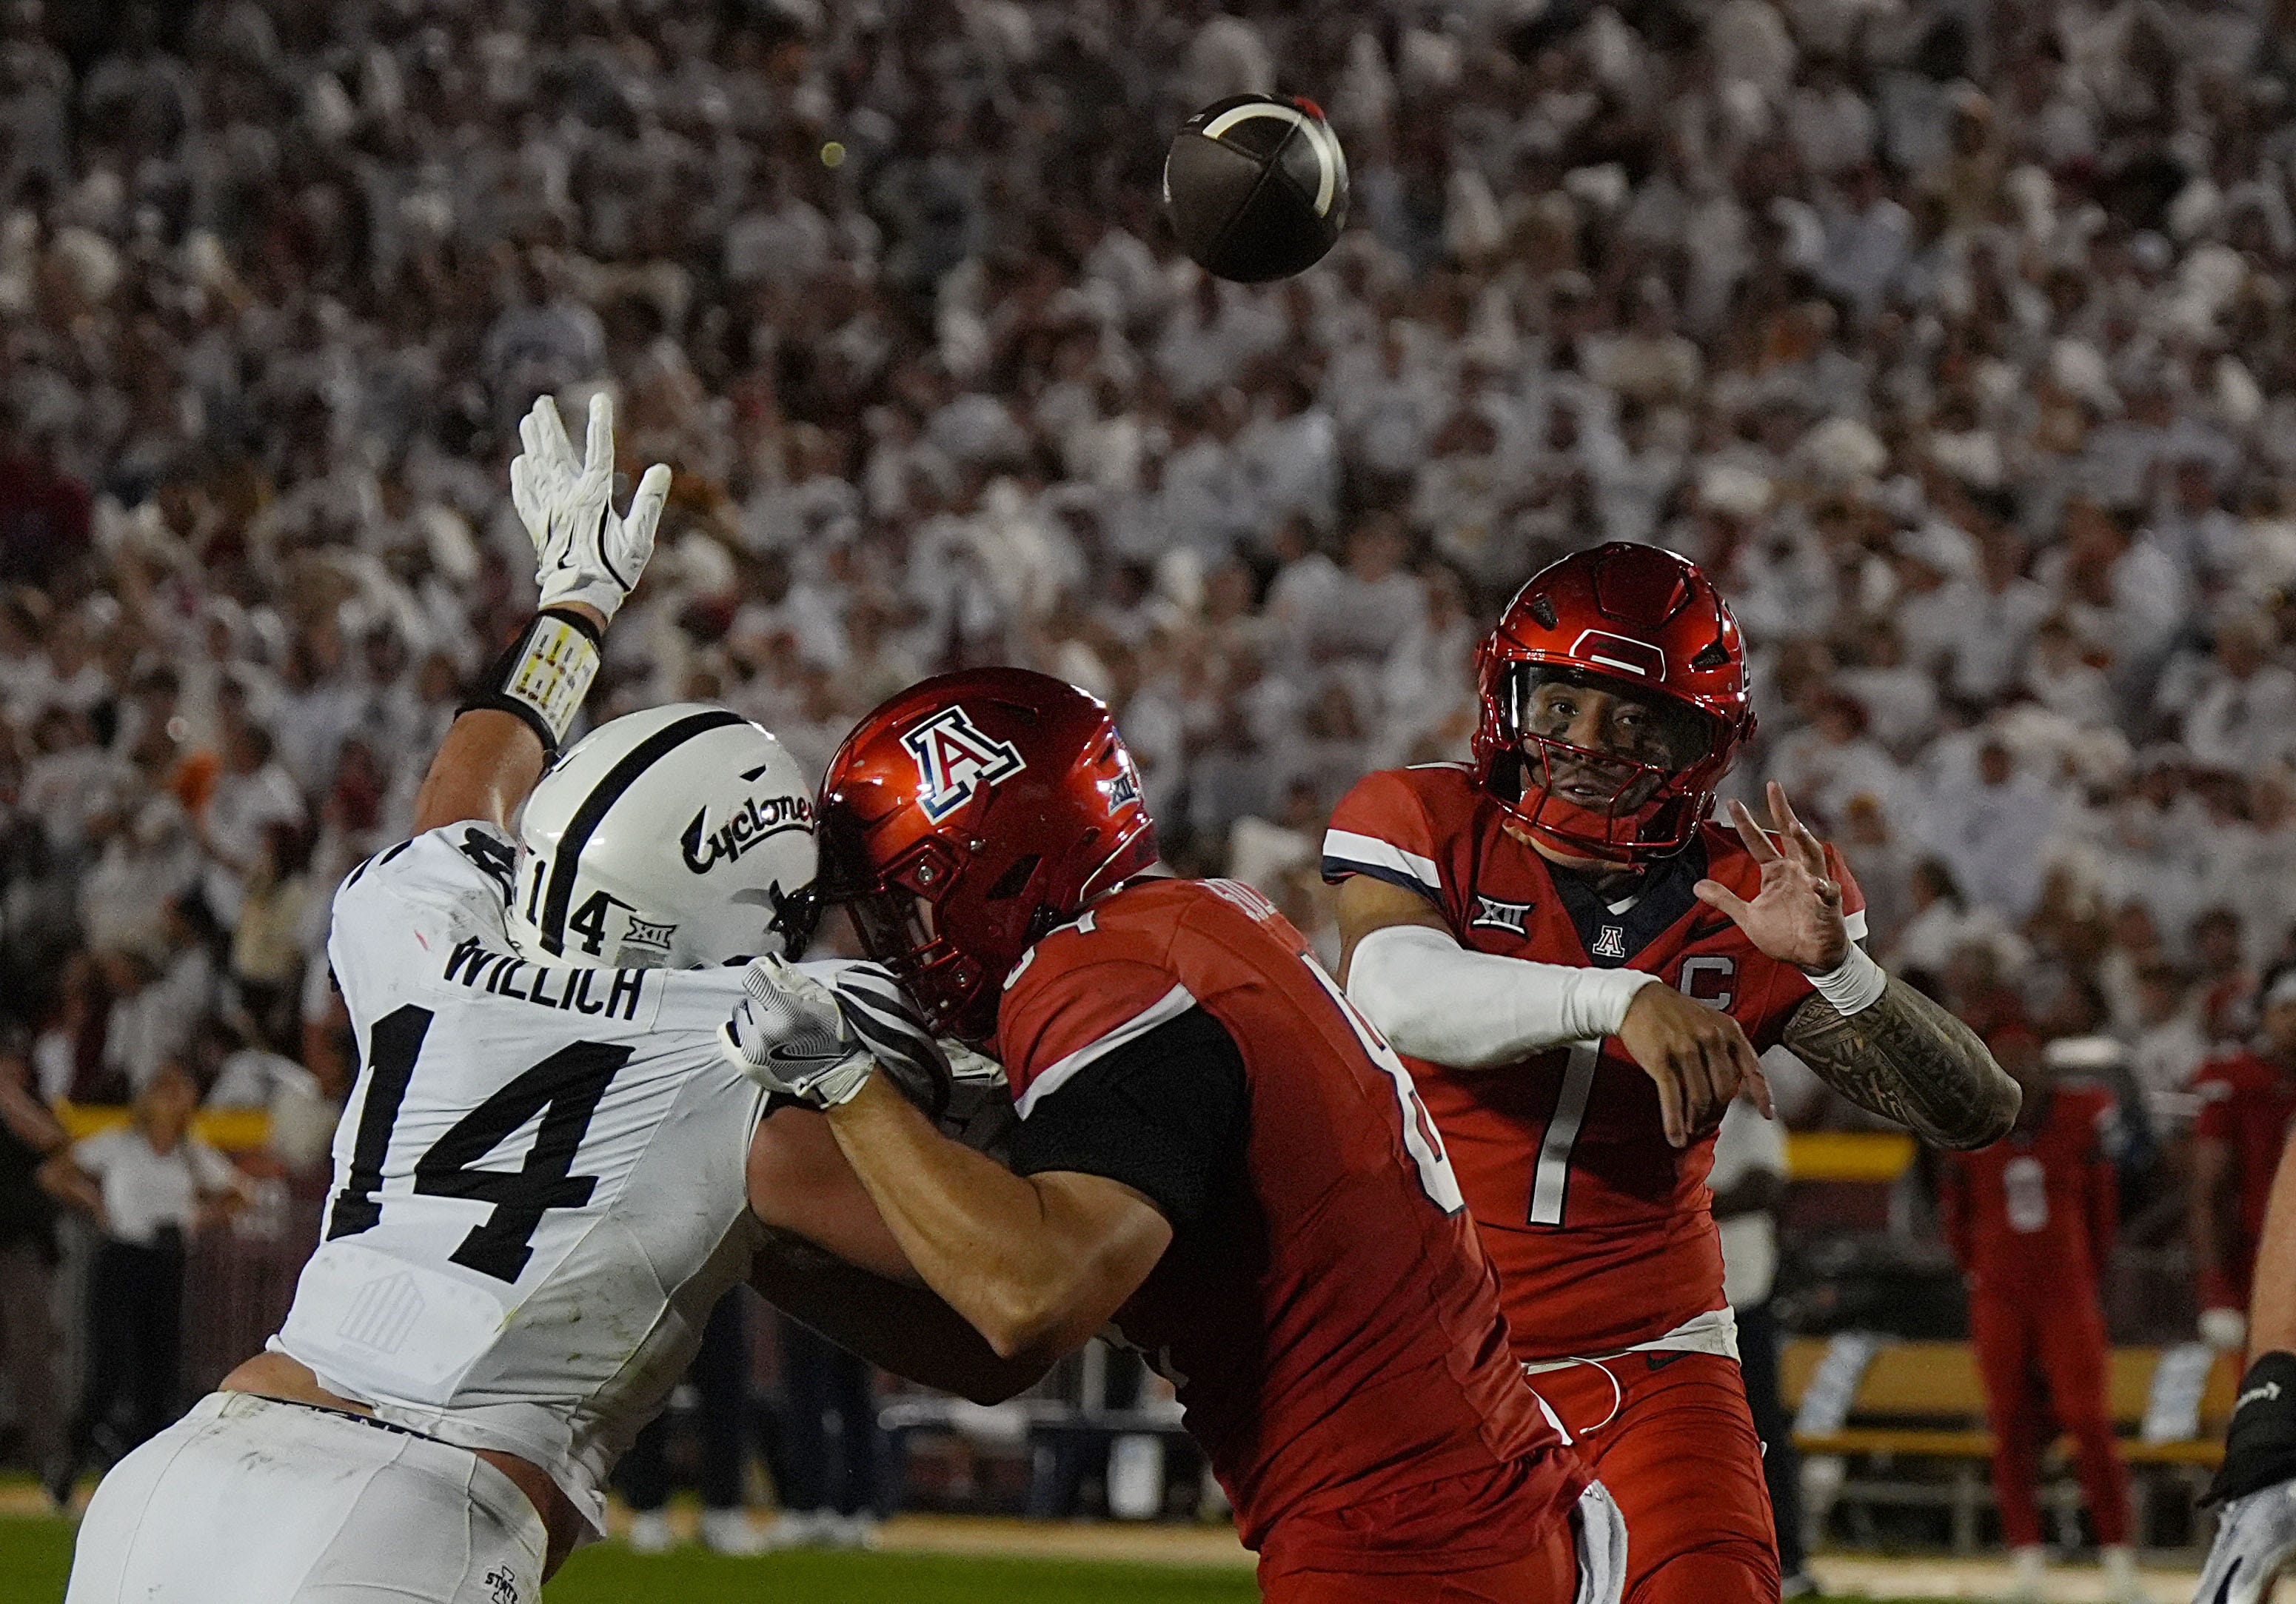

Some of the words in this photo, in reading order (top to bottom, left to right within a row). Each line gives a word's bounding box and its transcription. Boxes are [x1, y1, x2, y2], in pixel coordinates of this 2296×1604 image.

[899, 705, 1027, 826] A
[621, 915, 677, 949] XII
[1472, 895, 1533, 935] XII
[1593, 925, 1625, 958] A
[444, 935, 647, 1021] WILLICH
[1680, 957, 1733, 1010] C
[326, 1003, 636, 1285] 14
